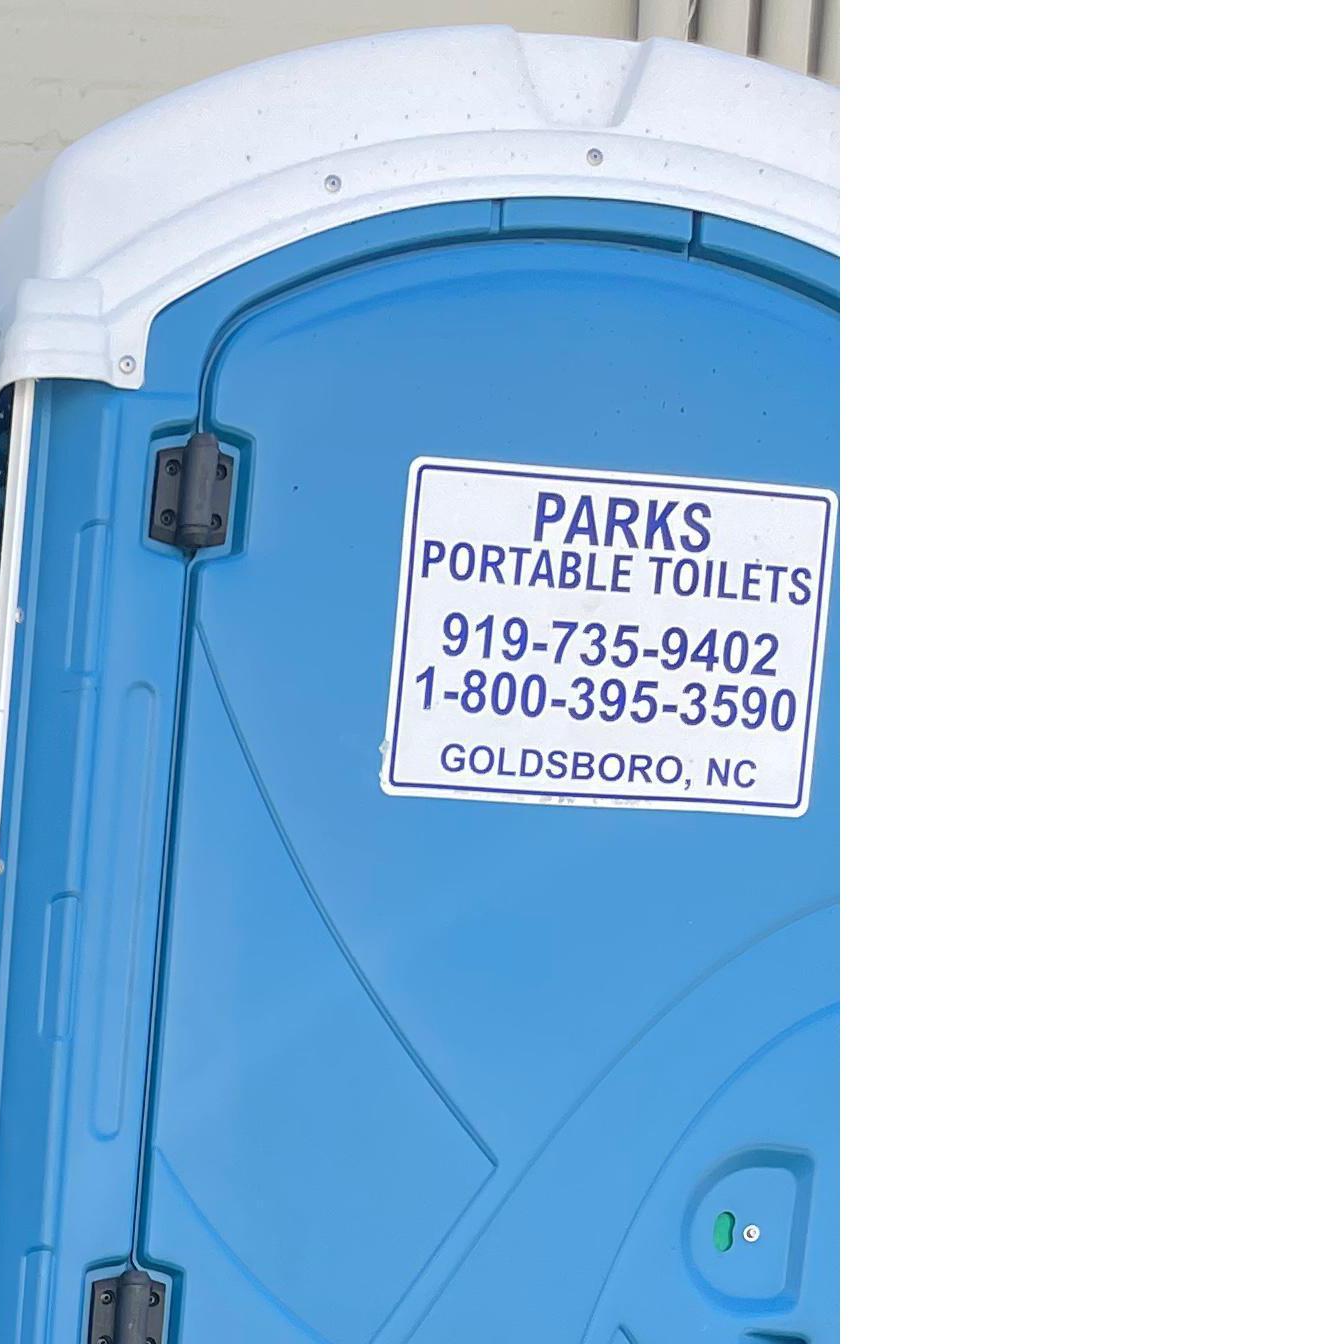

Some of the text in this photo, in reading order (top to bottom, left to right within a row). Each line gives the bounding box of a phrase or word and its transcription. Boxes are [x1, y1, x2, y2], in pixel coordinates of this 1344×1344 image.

[533, 491, 712, 553] PARKS
[420, 539, 813, 606] PORTABLE TOILETS
[441, 611, 779, 678] 919-735-9402
[414, 664, 797, 732] 1-800-395-3590
[439, 742, 758, 791] GOLDSBORO, NC
